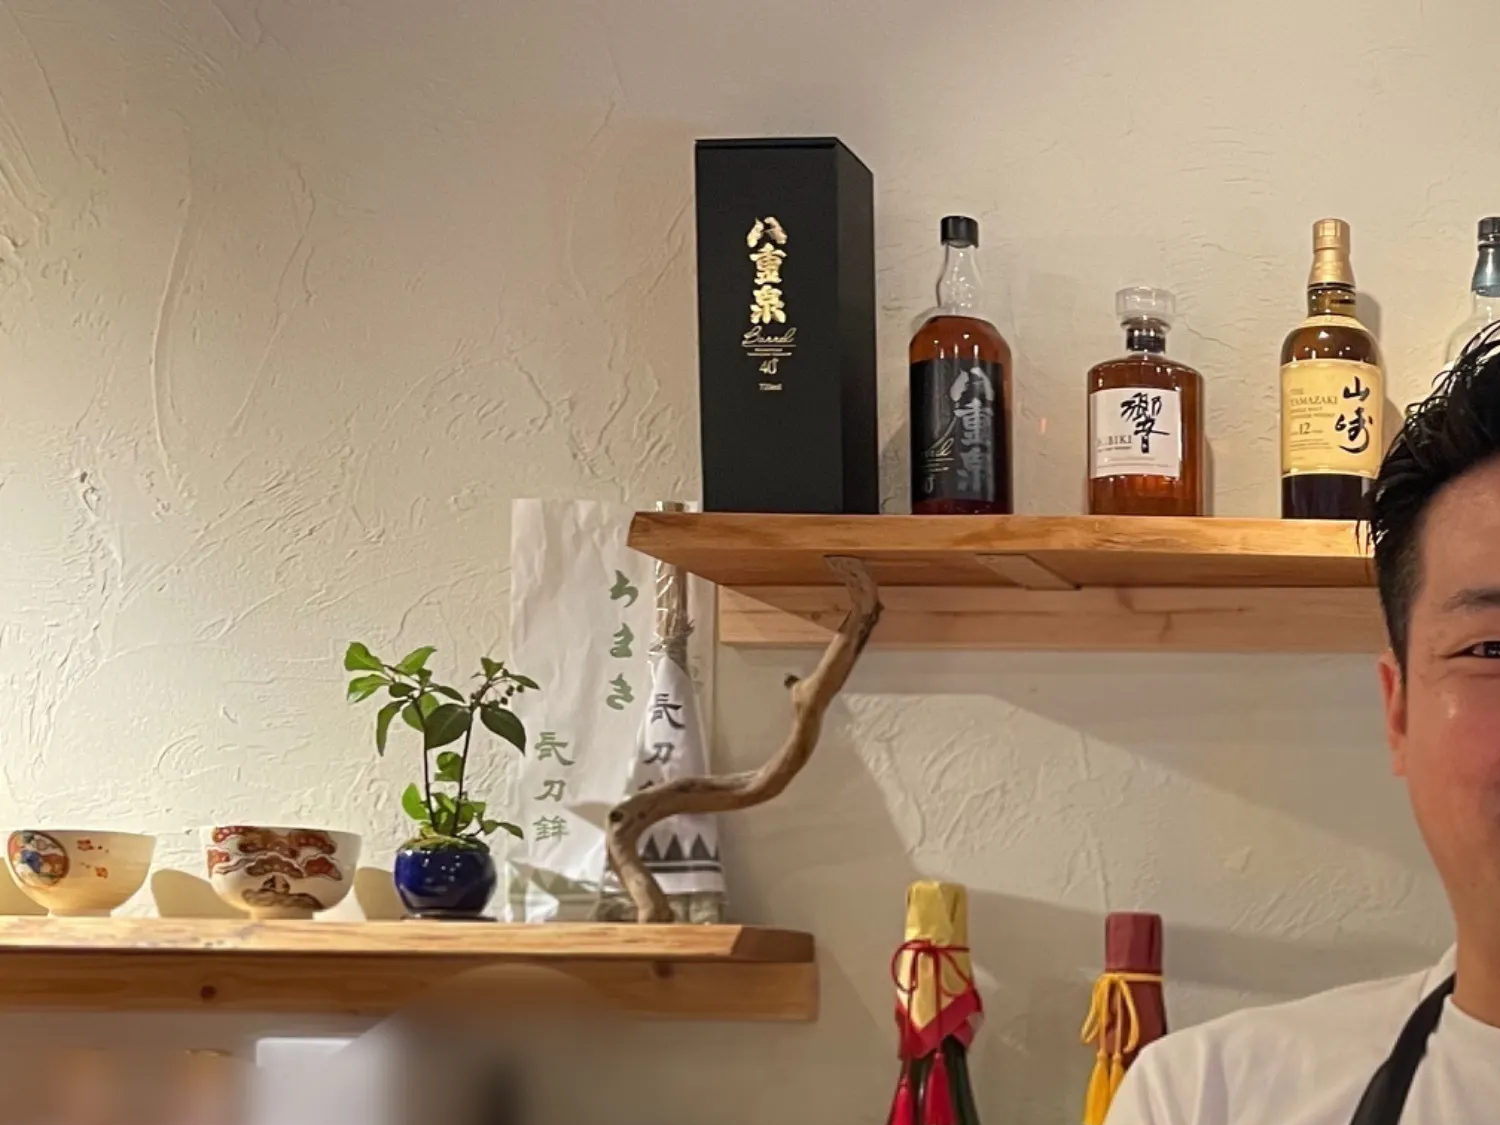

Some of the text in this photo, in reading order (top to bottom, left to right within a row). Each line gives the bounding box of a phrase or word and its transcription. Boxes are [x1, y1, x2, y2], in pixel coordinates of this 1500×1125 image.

[746, 216, 788, 324] 八重泉
[950, 366, 995, 501] 八重泉
[1120, 392, 1170, 455] 響
[1334, 376, 1374, 454] 山崎
[606, 569, 640, 711] ちまき
[532, 731, 575, 842] 長刀鉾
[639, 693, 686, 790] 長刀
